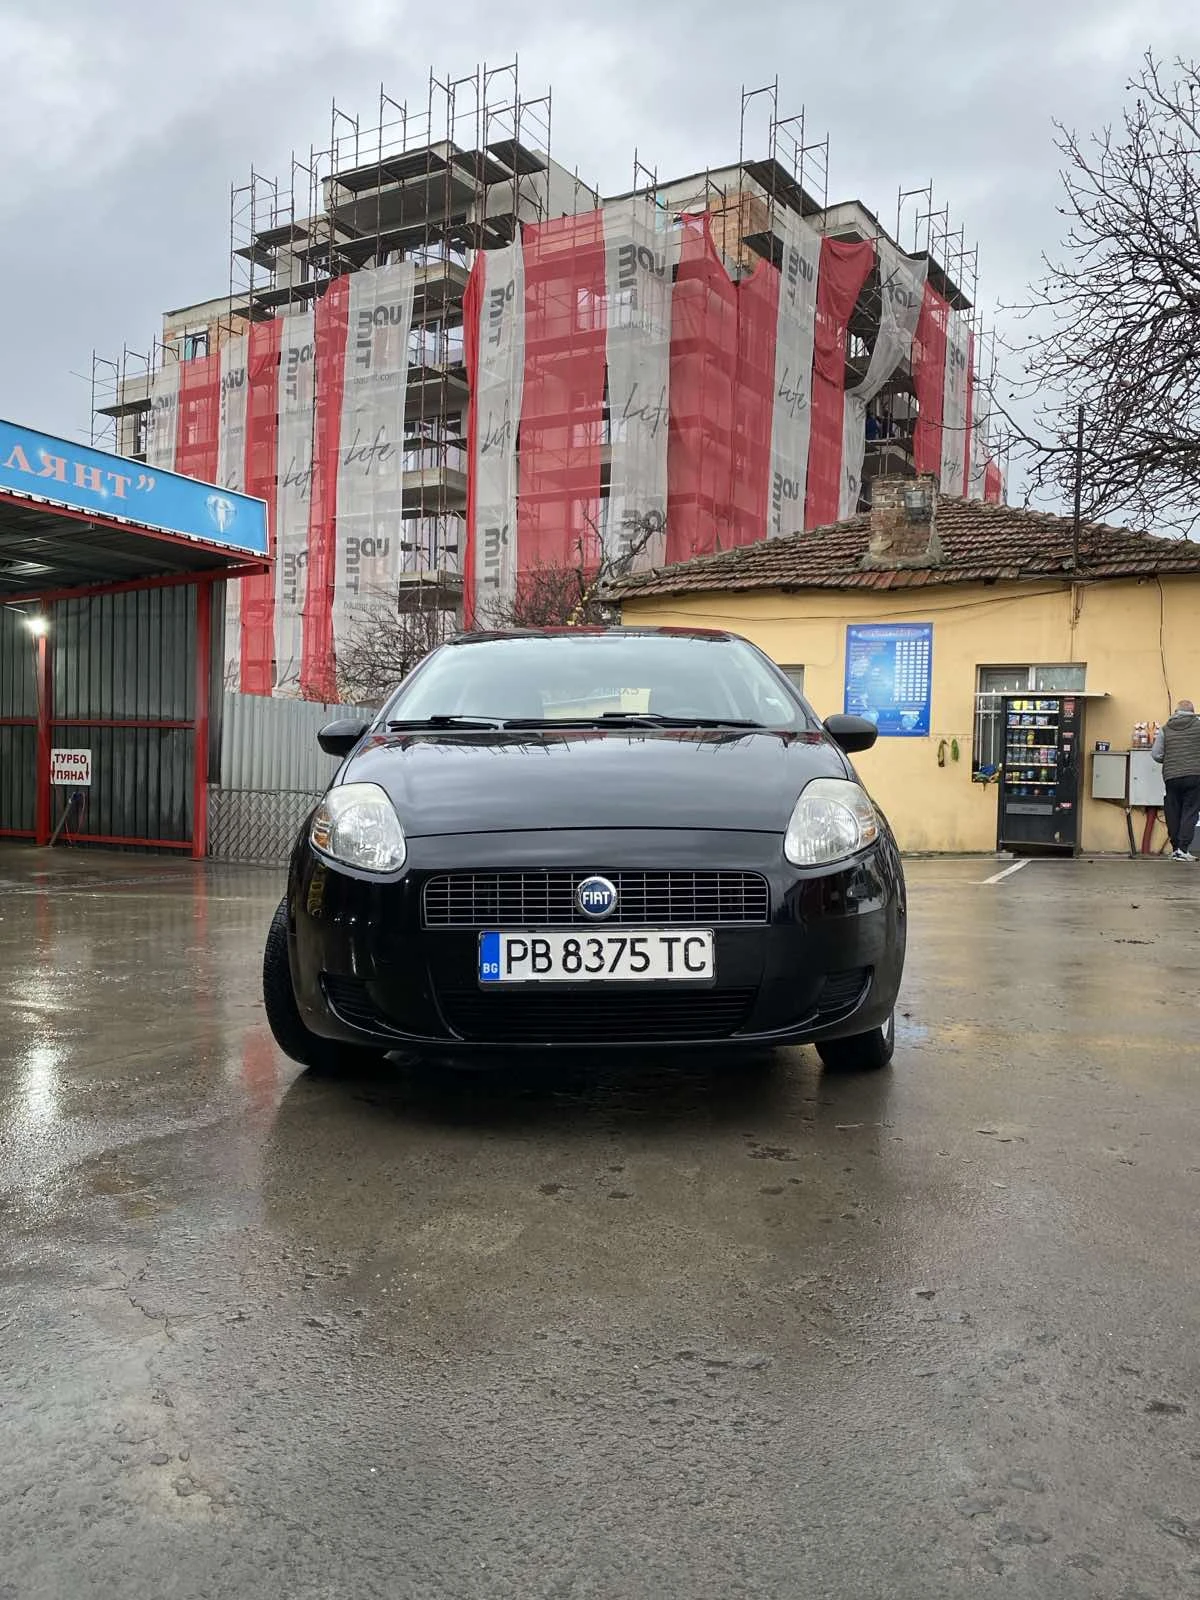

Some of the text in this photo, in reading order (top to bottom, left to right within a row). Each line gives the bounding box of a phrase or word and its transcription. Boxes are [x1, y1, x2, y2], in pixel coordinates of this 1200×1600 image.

[54, 753, 87, 764] ТУРБО
[56, 770, 85, 781] ПЯНА
[582, 890, 611, 905] FIAT
[506, 936, 706, 974] PB 8375 TC
[483, 963, 498, 974] BG
